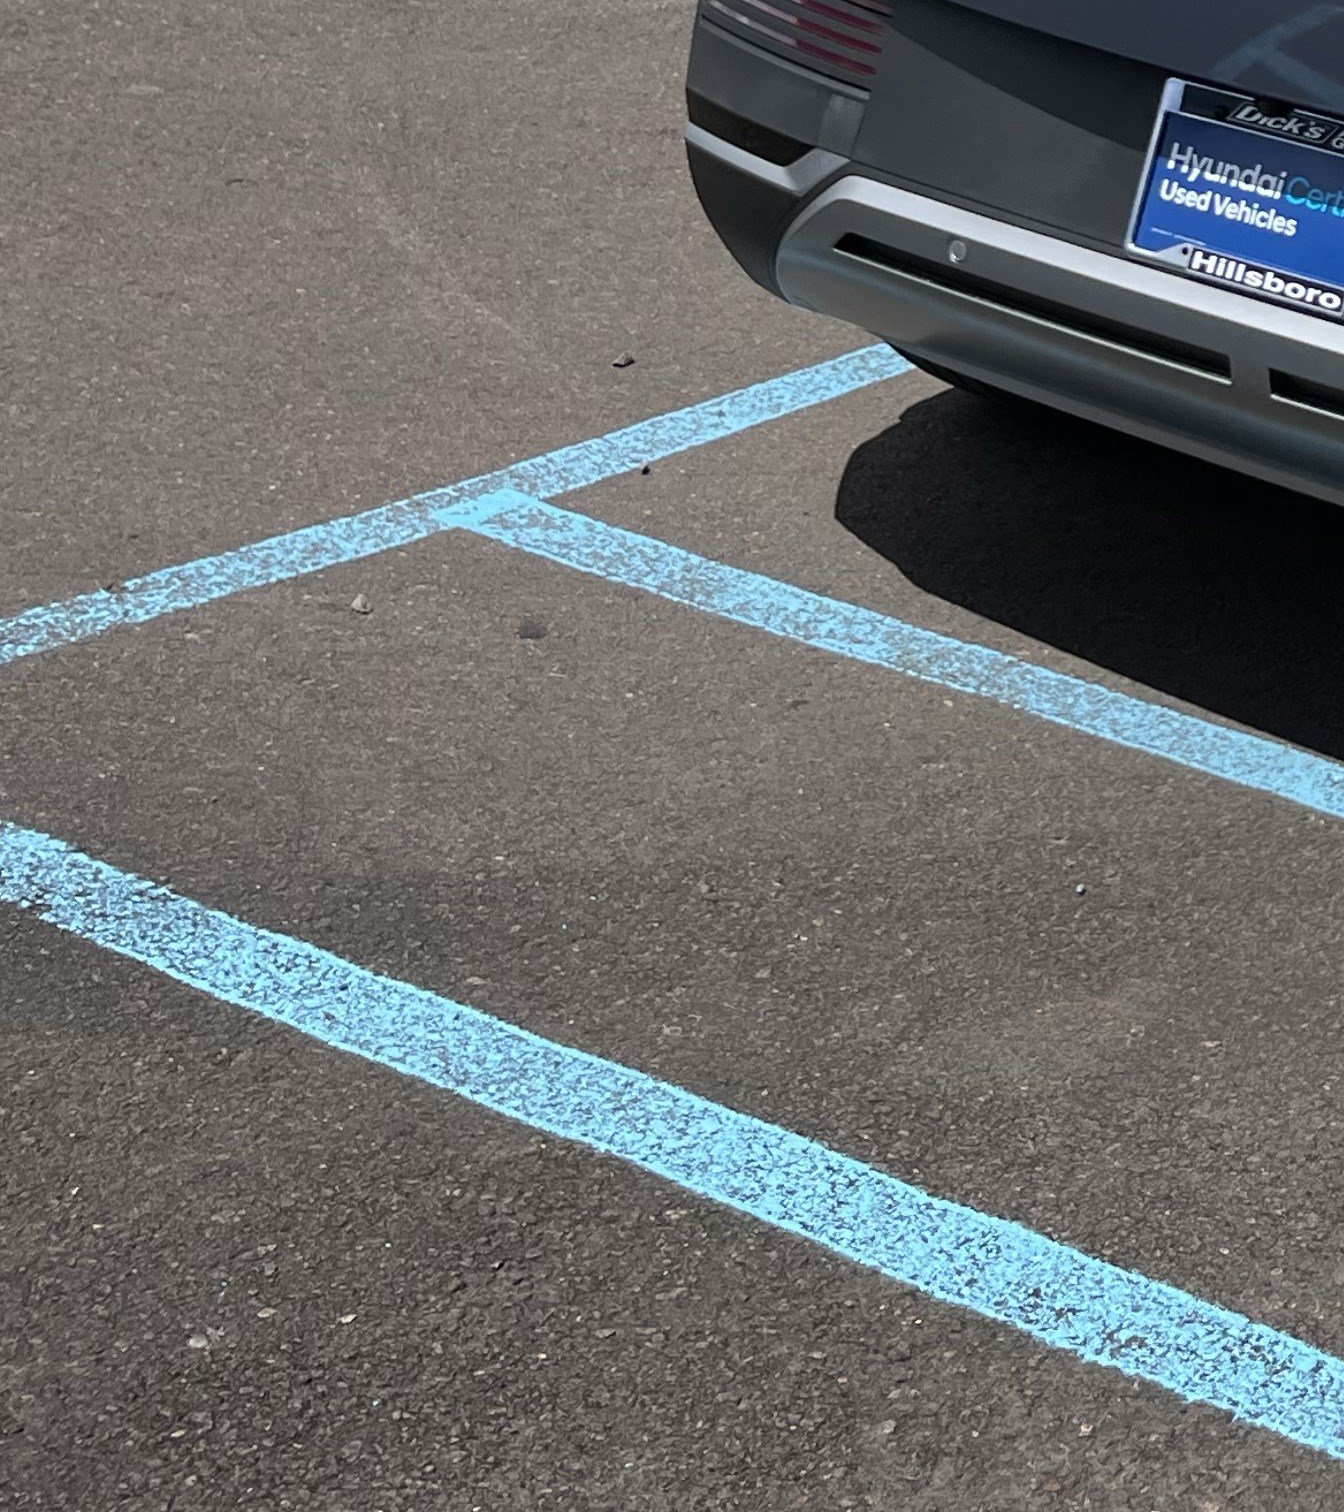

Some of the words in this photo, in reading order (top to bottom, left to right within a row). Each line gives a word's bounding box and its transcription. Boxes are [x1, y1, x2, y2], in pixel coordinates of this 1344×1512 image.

[1233, 102, 1327, 142] Dick's
[1166, 141, 1288, 201] Hyundai
[1159, 179, 1212, 212] Used
[1213, 194, 1299, 238] Vehicles
[1190, 248, 1343, 310] Hillsboro
